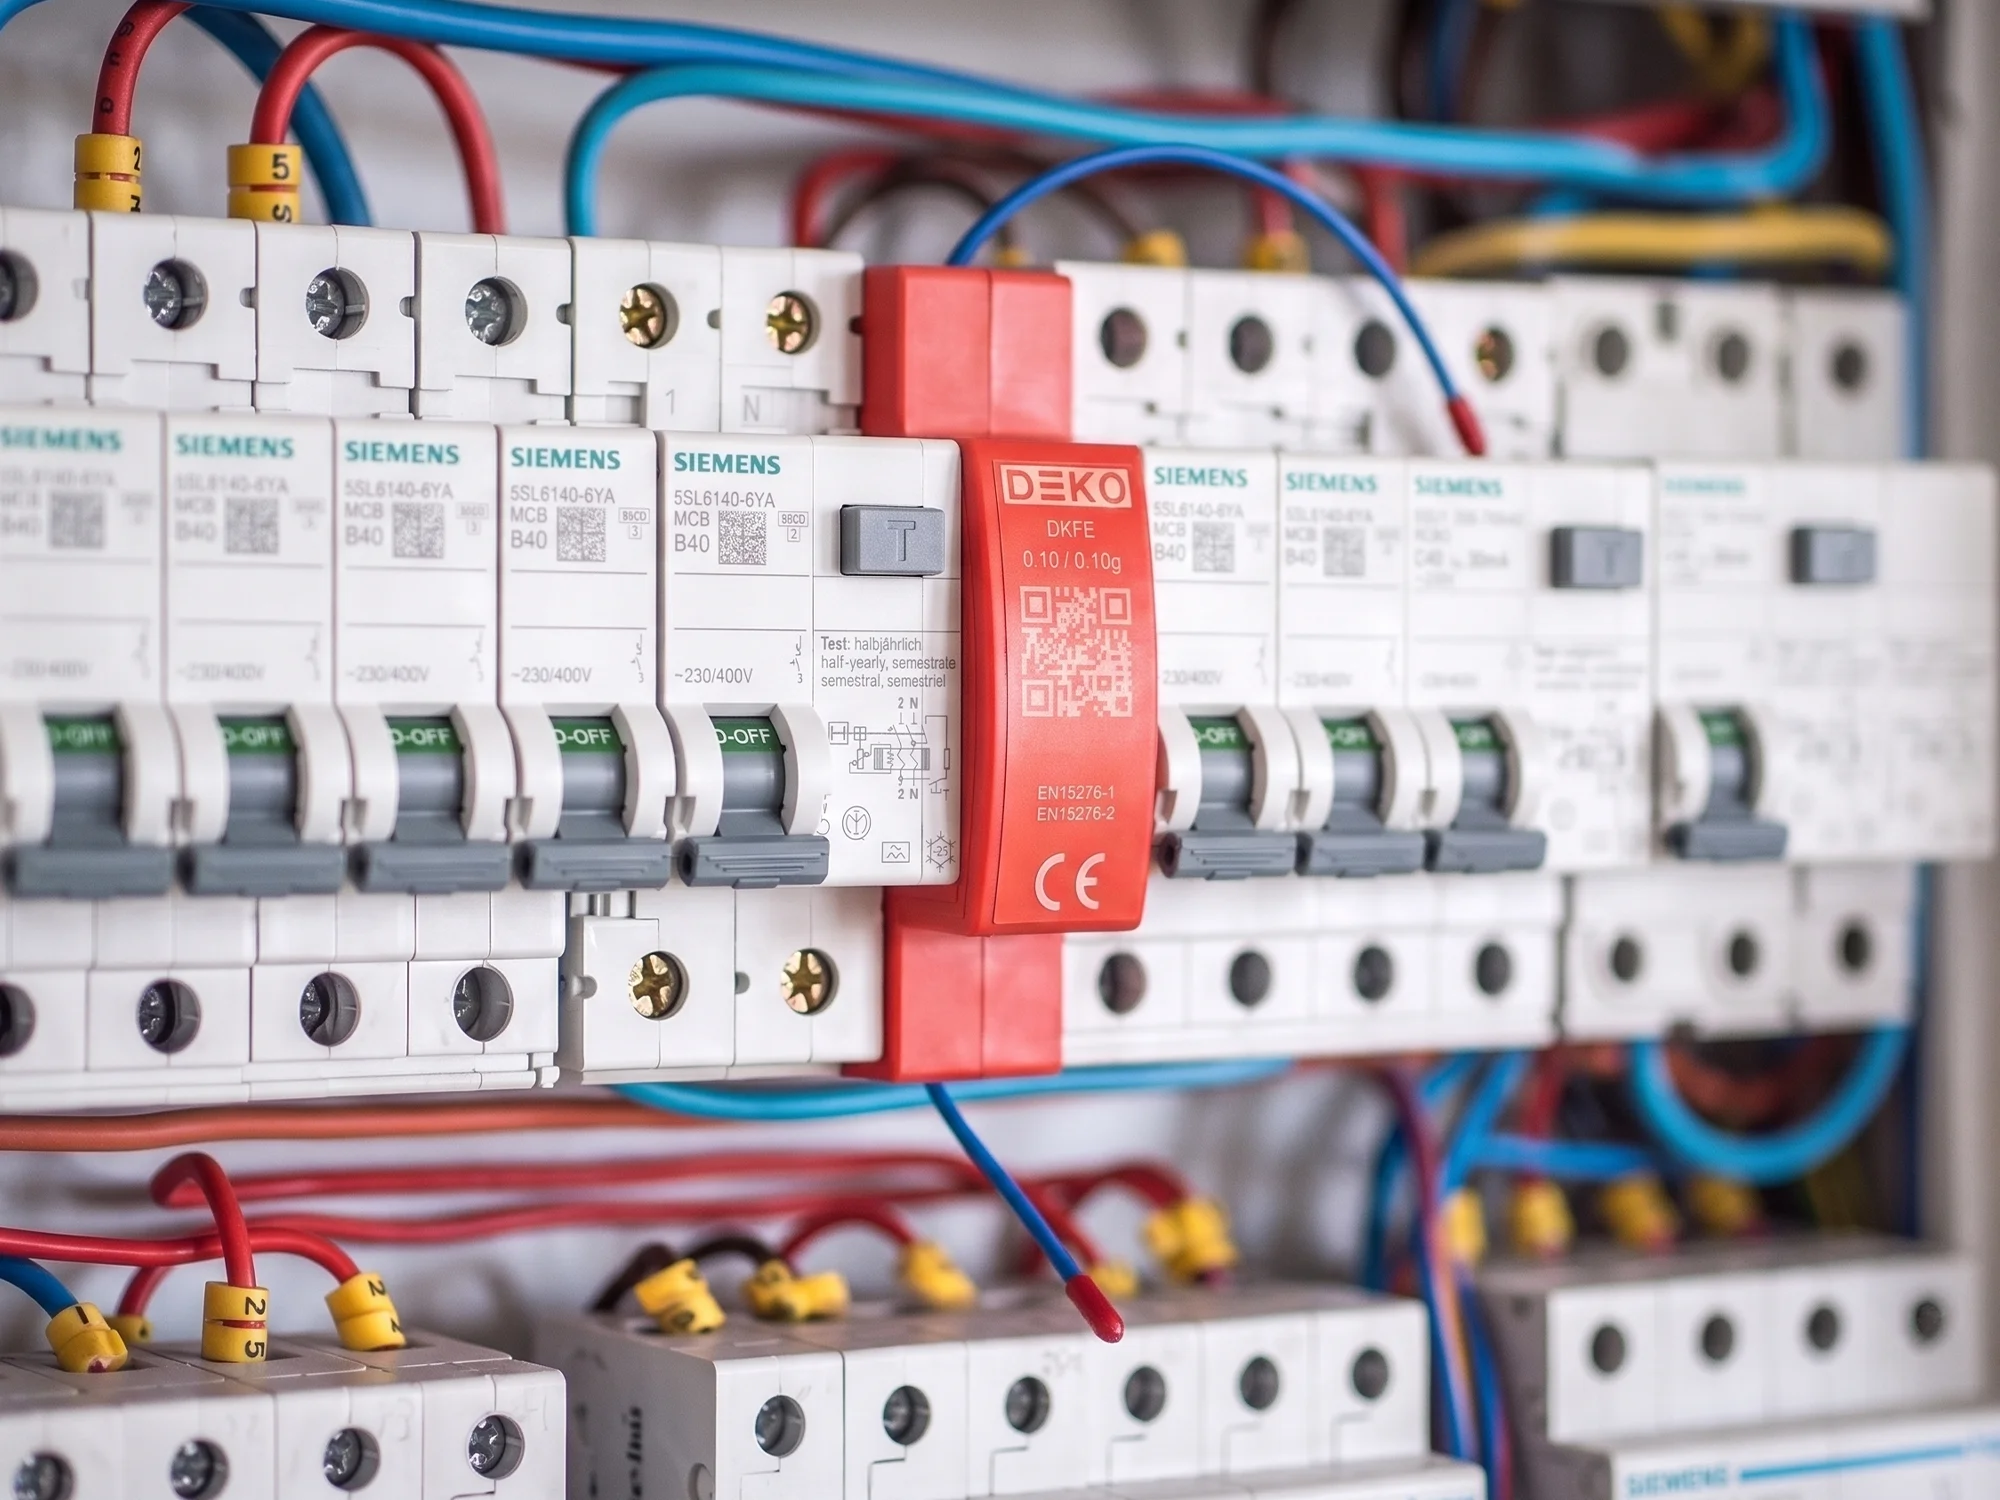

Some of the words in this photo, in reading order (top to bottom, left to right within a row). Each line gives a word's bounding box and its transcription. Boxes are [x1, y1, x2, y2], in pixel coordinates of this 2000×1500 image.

[272, 153, 290, 181] 5
[174, 433, 296, 459] SIEMENS
[344, 440, 461, 466] SIEMENS
[510, 446, 622, 471] SIEMENS
[673, 451, 781, 476] SIEMENS
[1005, 468, 1127, 505] DEKO
[1153, 465, 1248, 488] SIEMENS
[1285, 472, 1378, 494] SIEMENS
[510, 484, 616, 505] 5SL6140-6YA
[673, 489, 776, 509] 5SL6140-6YA
[343, 502, 385, 520] MCB
[510, 506, 548, 523] MCB
[673, 510, 711, 527] MCB
[344, 524, 384, 547] B40
[790, 528, 798, 540] 2
[1046, 519, 1096, 539] DKFE
[1153, 522, 1187, 538] MCB
[510, 529, 548, 550] B40
[673, 533, 711, 553] B40
[886, 519, 917, 562] T
[1022, 549, 1060, 569] 0.10
[1073, 551, 1122, 575] 0.10g
[1154, 543, 1187, 562] B40
[820, 635, 852, 651] Test:
[820, 655, 890, 673] half-yearly,
[820, 674, 885, 689] semestral,
[887, 674, 946, 688] semestriel
[897, 696, 905, 709] 2
[909, 696, 919, 709] N
[897, 788, 905, 800] 2
[909, 788, 919, 800] N
[1037, 785, 1115, 800] EN15276-1
[1036, 806, 1116, 821] EN15276-2
[1034, 852, 1106, 911] CE
[244, 1296, 266, 1316] 2
[244, 1340, 265, 1359] 5
